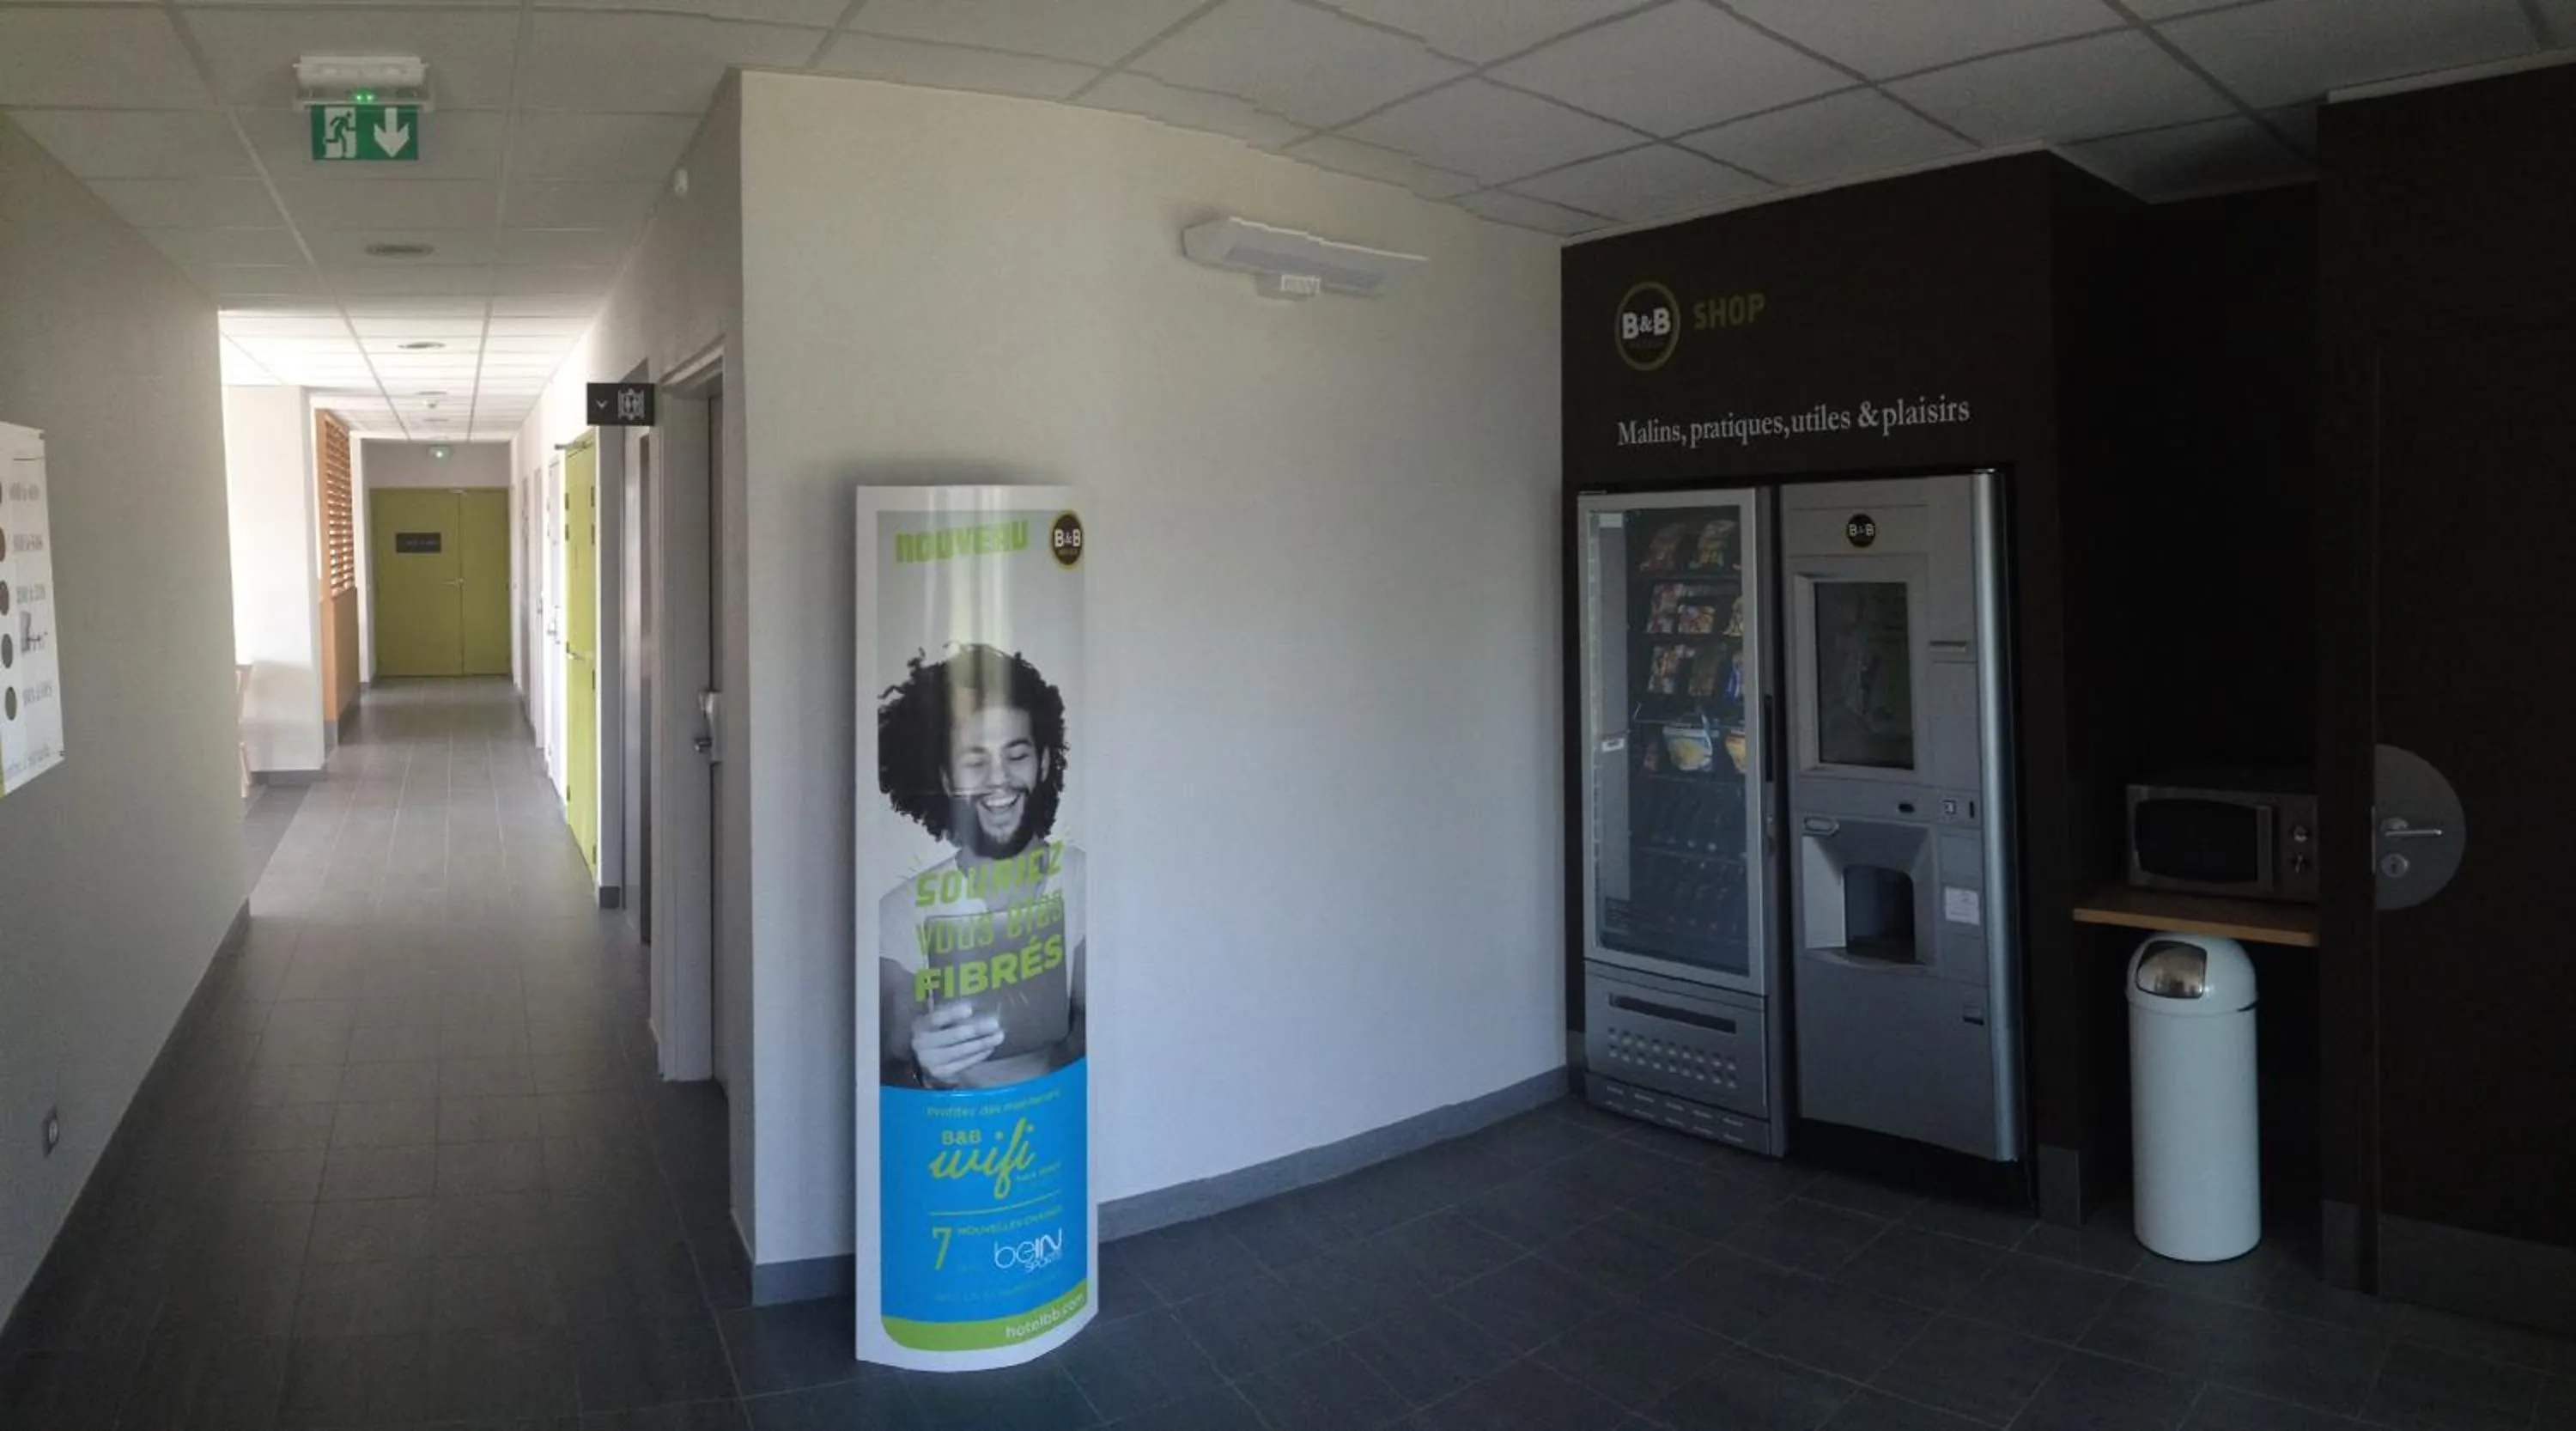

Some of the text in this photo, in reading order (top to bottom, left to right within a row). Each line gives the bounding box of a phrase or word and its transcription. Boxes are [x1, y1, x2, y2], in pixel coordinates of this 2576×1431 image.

[1622, 292, 1766, 339] B&B SHOP
[1617, 417, 1686, 447] Malins,
[1689, 411, 1790, 449] pratiques,
[1791, 403, 1851, 433] utiles
[1881, 393, 1971, 436] plaisirs
[895, 520, 1029, 563] NOUVEAU
[1053, 528, 1082, 547] B&B
[1849, 523, 1874, 537] B&B
[915, 840, 1064, 908] SOURIEZ
[914, 934, 1063, 1002] FIBRÉS
[928, 1116, 1036, 1199] wifi
[932, 1227, 952, 1270] 7
